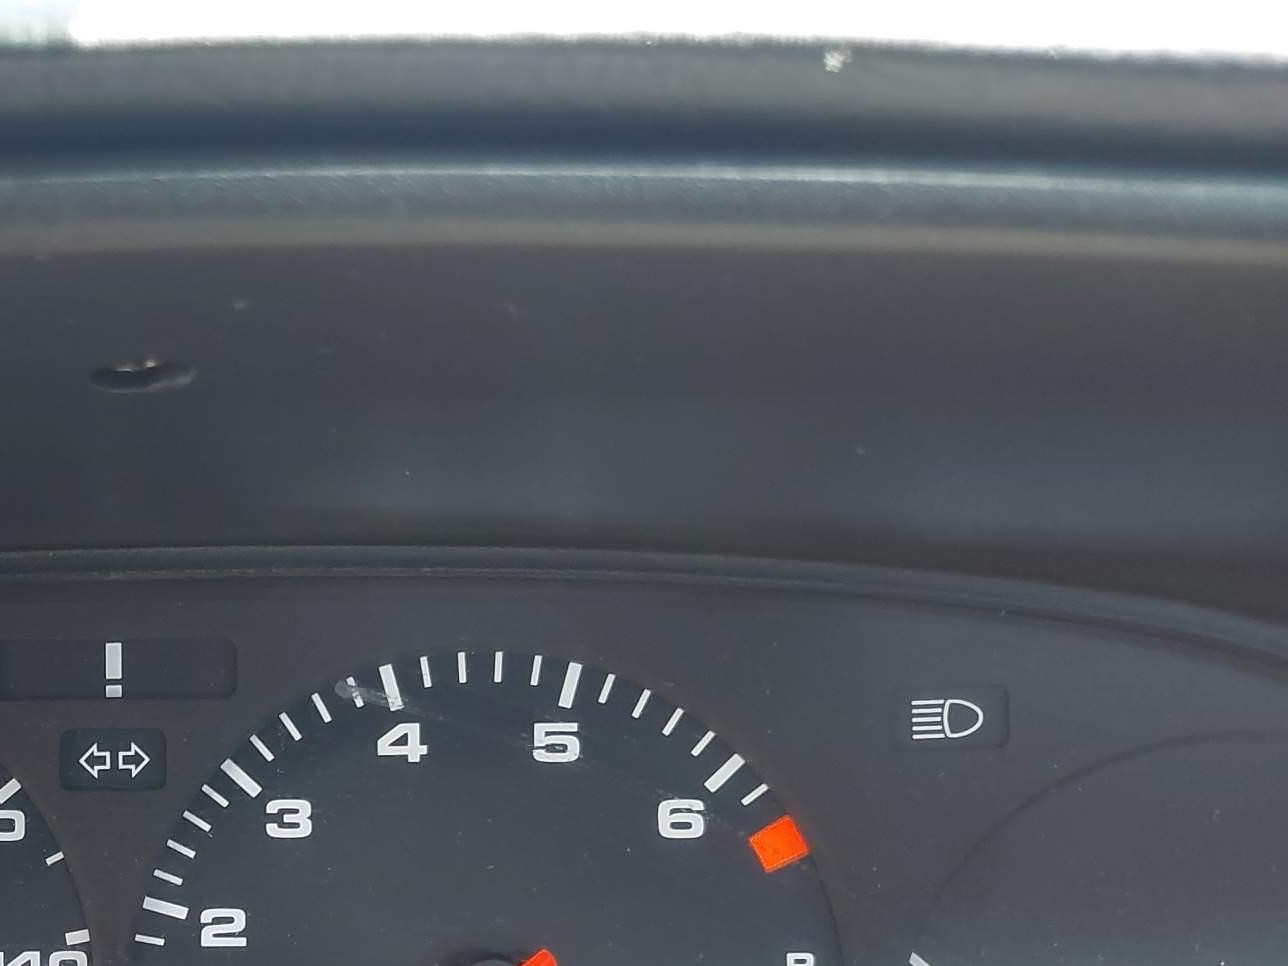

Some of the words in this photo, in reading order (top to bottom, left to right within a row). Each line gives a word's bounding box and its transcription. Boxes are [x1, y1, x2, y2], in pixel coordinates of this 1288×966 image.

[376, 722, 428, 763] 4
[532, 722, 580, 763] 5
[264, 798, 312, 839] 3
[657, 798, 705, 838] 6
[200, 907, 247, 947] 2
